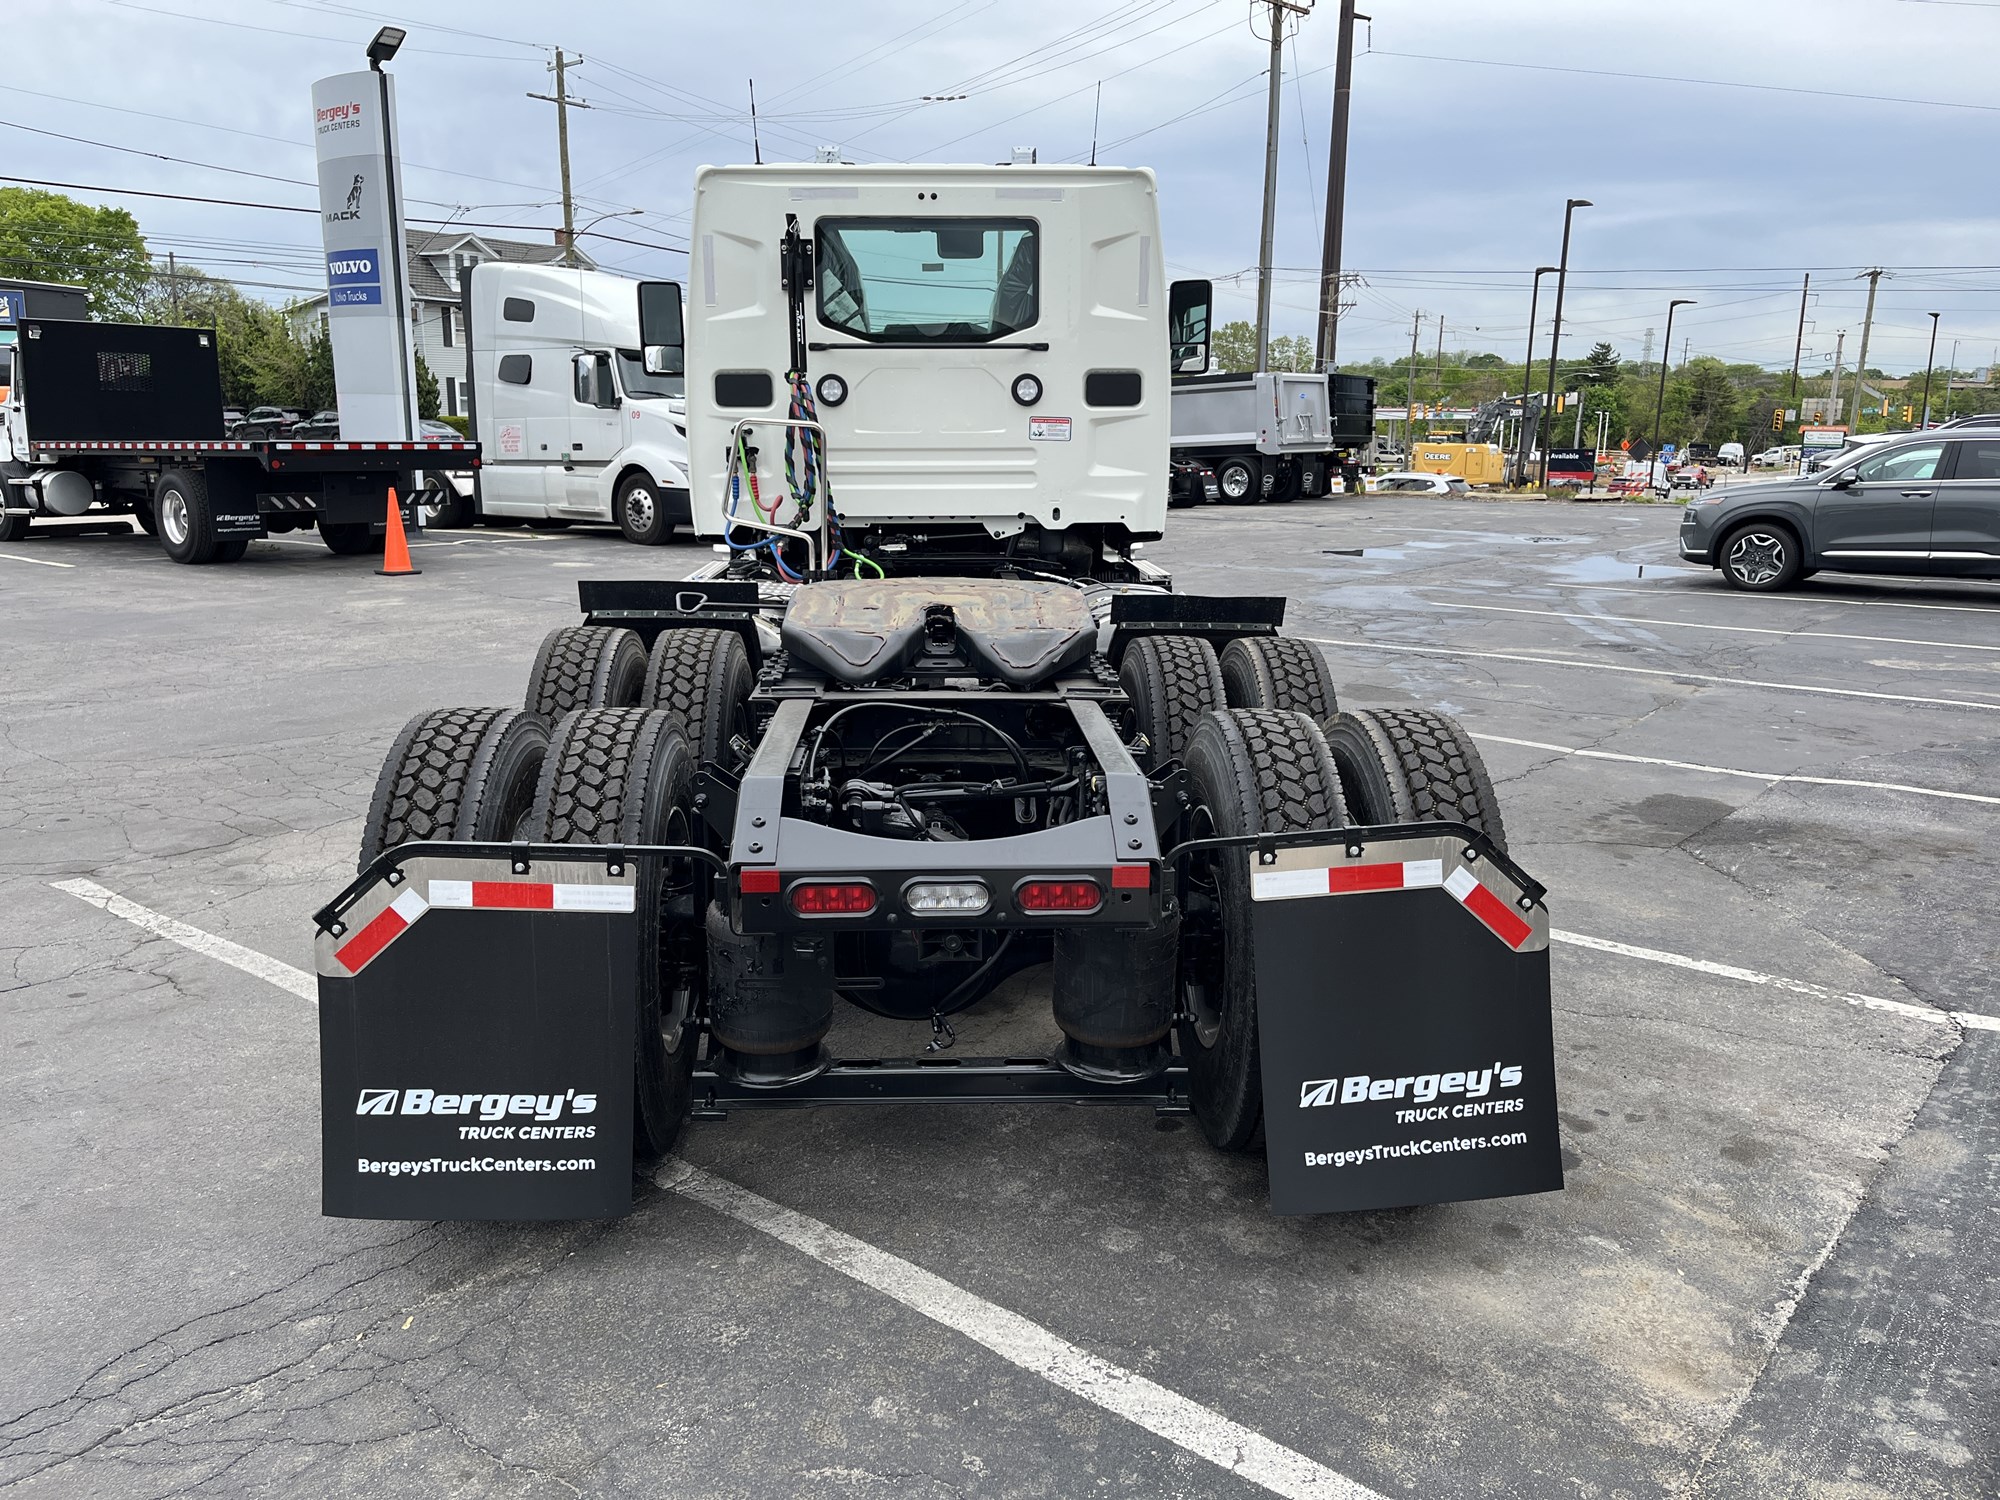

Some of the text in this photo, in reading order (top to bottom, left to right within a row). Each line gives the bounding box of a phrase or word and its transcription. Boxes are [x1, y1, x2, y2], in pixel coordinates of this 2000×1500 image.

[317, 101, 360, 122] Bergey's
[331, 119, 360, 131] CENTERS
[326, 210, 360, 223] MACK
[329, 259, 372, 275] VOLVO
[347, 290, 368, 302] Trucks
[631, 410, 641, 420] 09
[1424, 452, 1451, 460] DEERE
[1340, 1061, 1523, 1104] Bergey's
[400, 1088, 597, 1122] Bergey's
[1395, 1098, 1524, 1124] TRUCK CENTERS
[458, 1125, 597, 1140] TRUCK CENTERS
[1304, 1131, 1528, 1167] BergeysTruckCenters.com
[358, 1157, 596, 1177] BergeysTruckCenters.com
